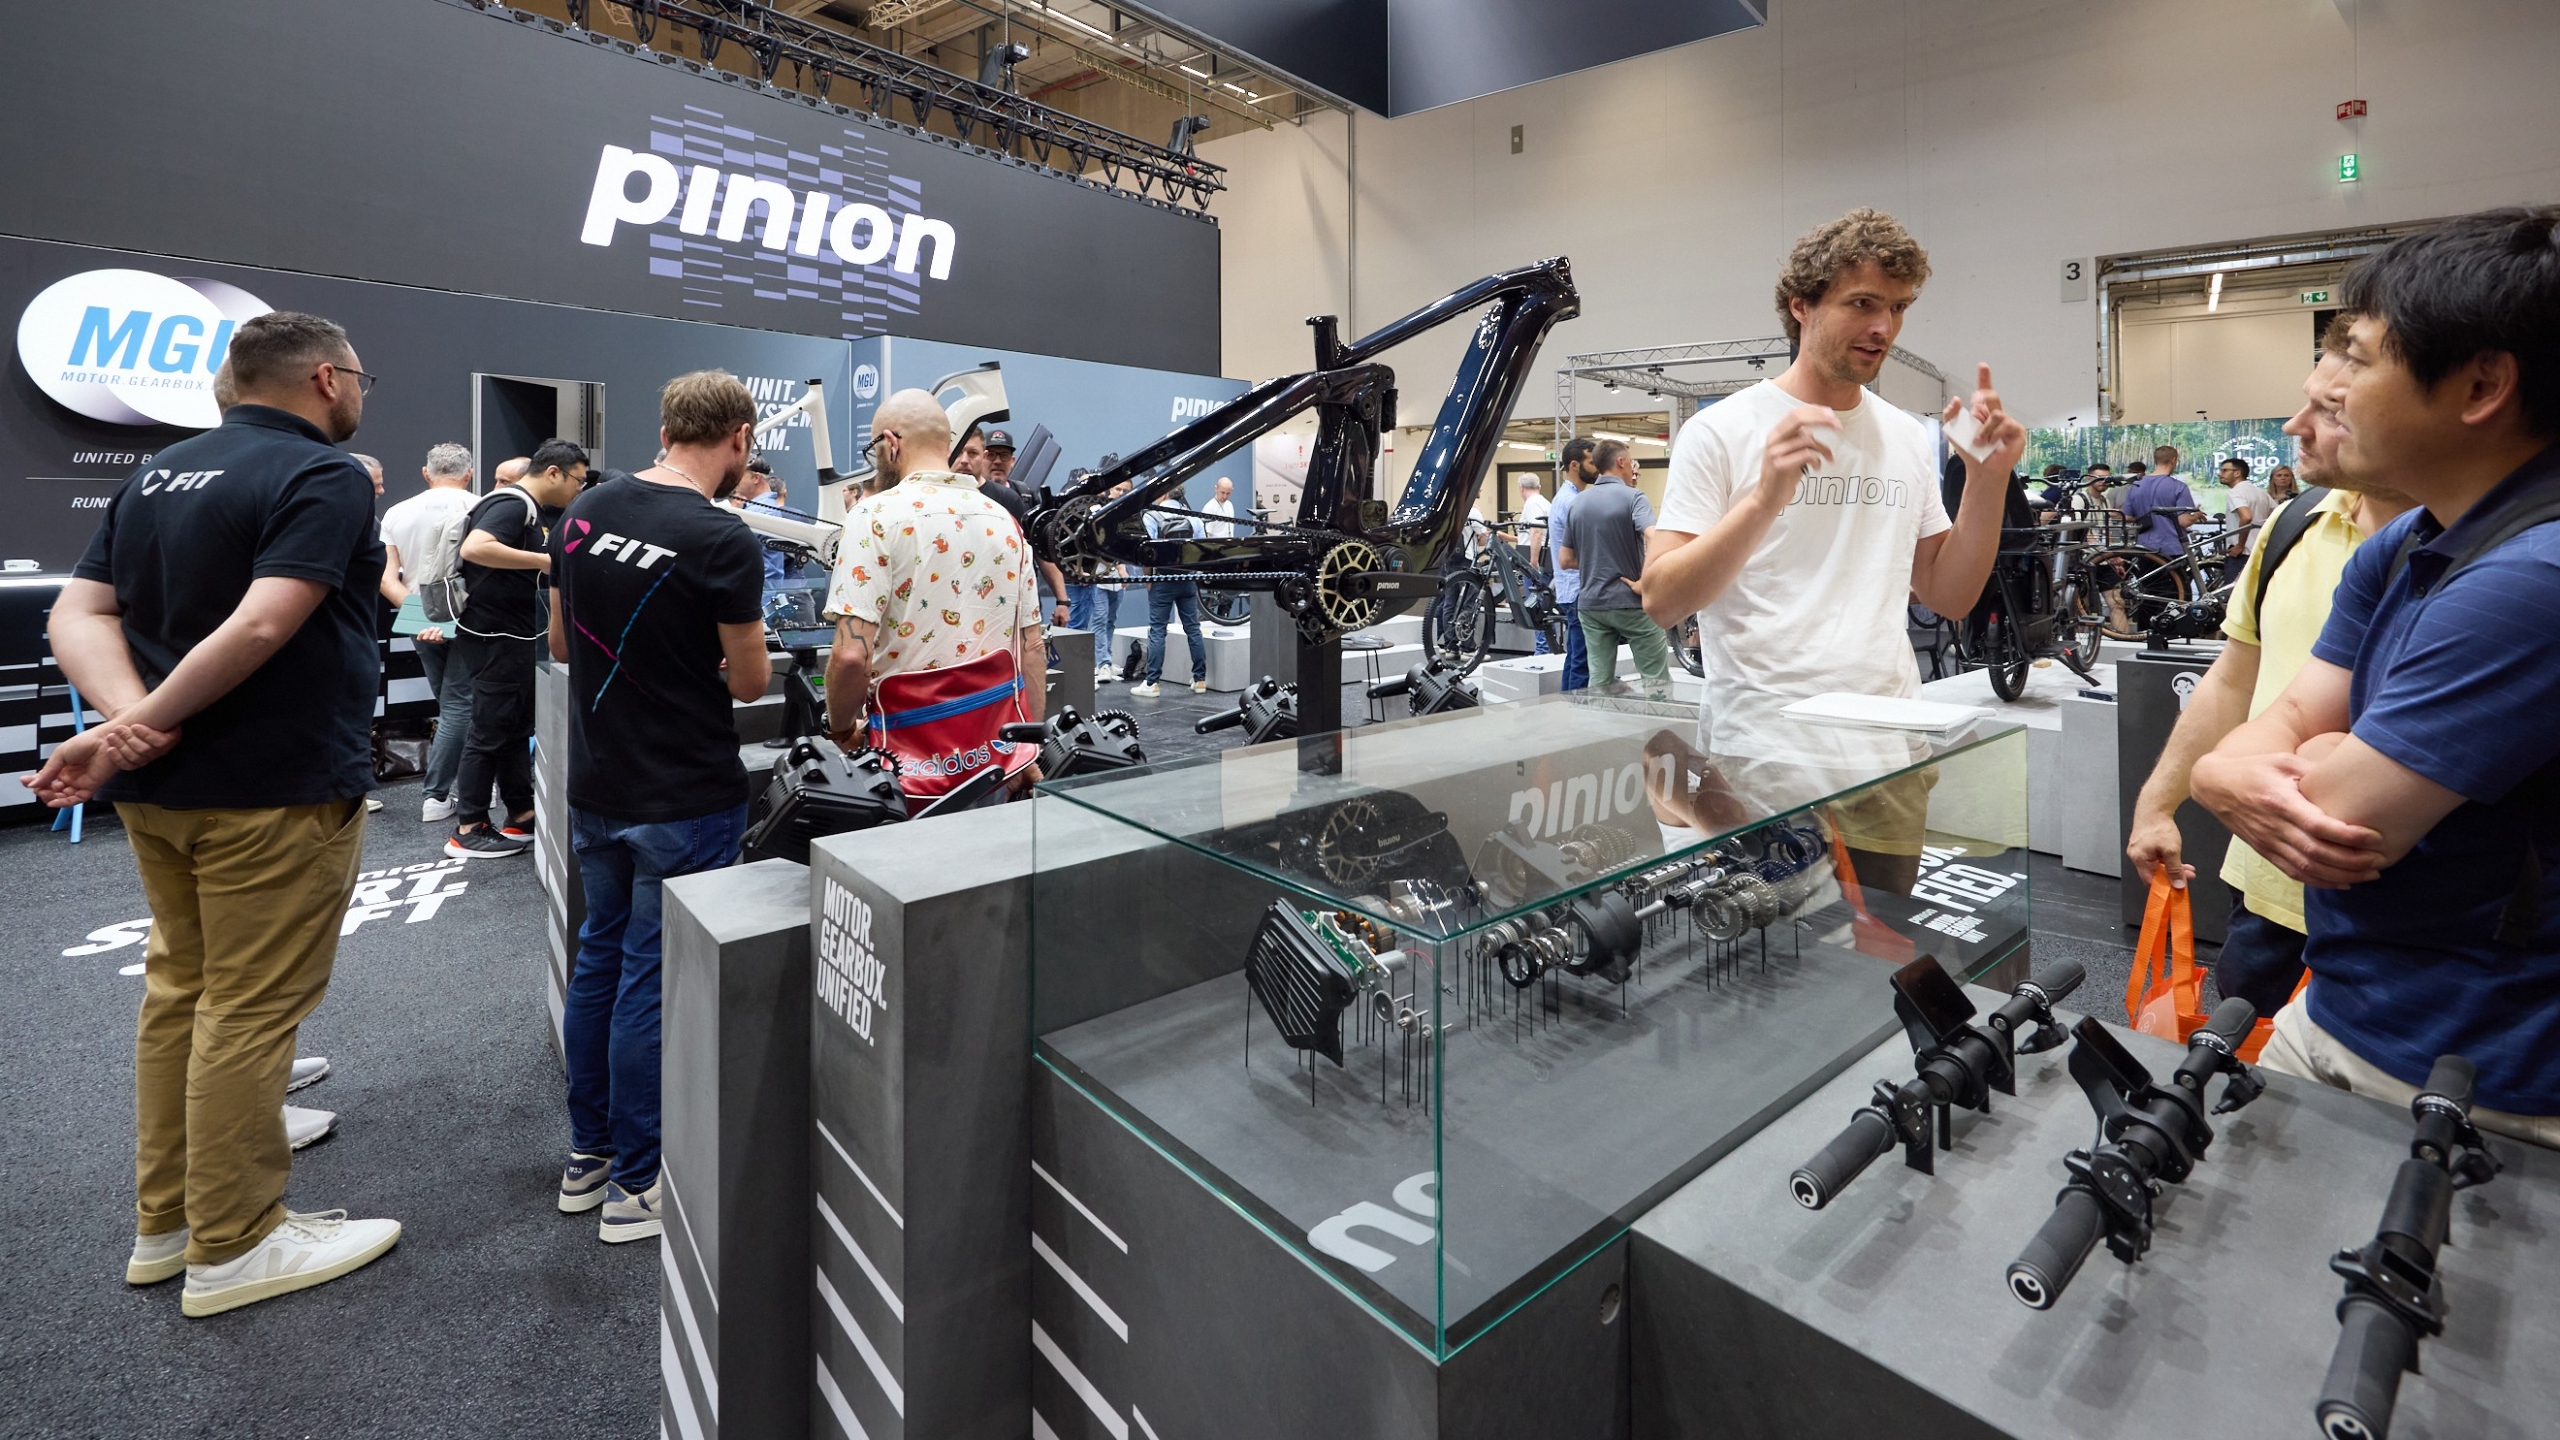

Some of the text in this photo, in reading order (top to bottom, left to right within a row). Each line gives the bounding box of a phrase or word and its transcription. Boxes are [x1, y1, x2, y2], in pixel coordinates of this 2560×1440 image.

[580, 144, 956, 281] pinion
[2066, 262, 2081, 280] 3
[745, 376, 797, 402] UNIT.
[857, 373, 876, 389] MGU
[1170, 396, 1225, 422] pini
[753, 428, 791, 451] AM.
[73, 452, 158, 465] UNITED B
[2212, 450, 2281, 475] Plago
[164, 469, 225, 492] FIT
[588, 532, 678, 570] FIT
[1376, 582, 1400, 592] pinion
[900, 744, 991, 777] adidas
[357, 857, 468, 880] nion
[1910, 863, 2029, 913] FIED.
[823, 876, 875, 952] MOTOR.
[820, 918, 887, 1011] GEARBOX.
[816, 956, 875, 1047] UNIFIED.
